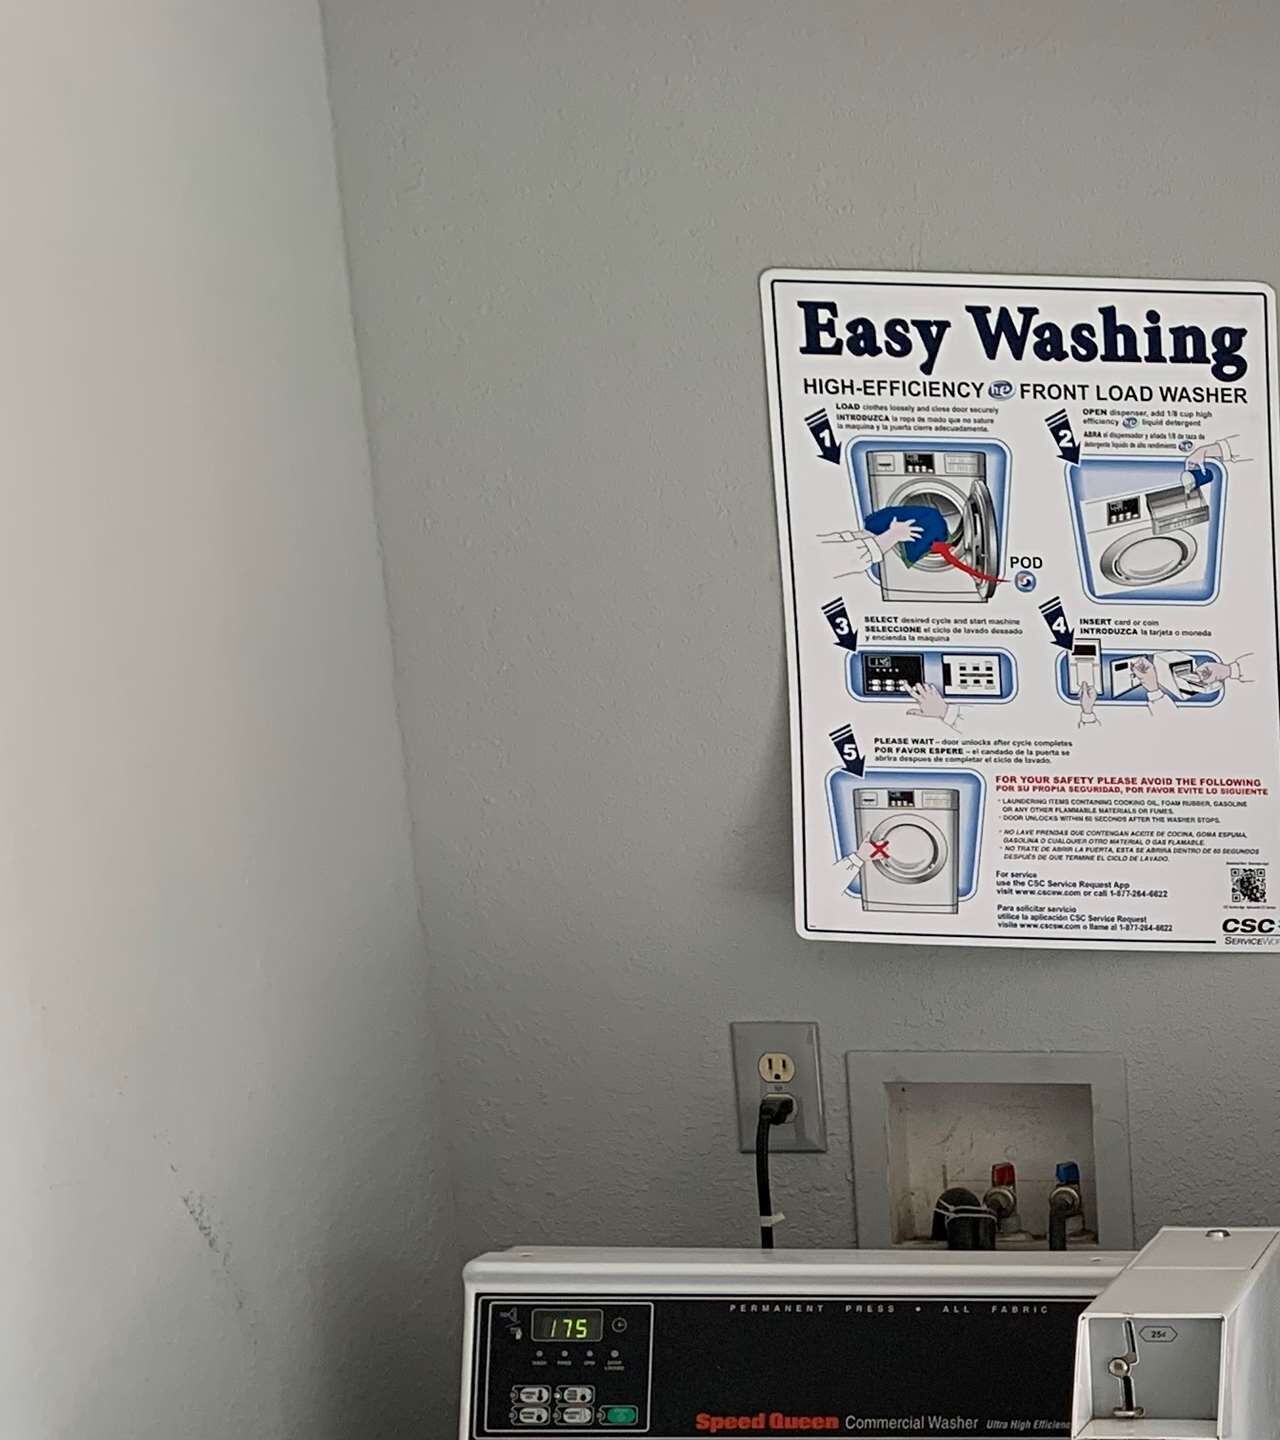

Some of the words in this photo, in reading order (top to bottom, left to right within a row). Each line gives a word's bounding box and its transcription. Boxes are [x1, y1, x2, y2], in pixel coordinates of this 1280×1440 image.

[797, 300, 951, 375] Easy
[965, 304, 1248, 381] Washing
[804, 378, 984, 398] HIGH-EFFICIENCY
[1020, 383, 1087, 400] FRONT
[1096, 385, 1152, 401] LOAD
[1160, 386, 1246, 403] WASHER
[819, 429, 831, 447] 1
[1058, 430, 1073, 448] 2
[1010, 556, 1042, 568] POD
[834, 617, 849, 635] 3
[1052, 616, 1067, 634] 4
[843, 744, 857, 761] 5
[996, 775, 1016, 783] FOR
[1053, 776, 1092, 784] SAFETY
[1097, 776, 1136, 784] PLEASE
[1141, 777, 1172, 785] AVOID
[1176, 777, 1196, 785] THE
[1199, 778, 1260, 786] FOLLOWING
[1177, 786, 1203, 794] EVITE
[1222, 918, 1275, 933] CSC
[730, 1304, 823, 1312] PERMANENT
[845, 1304, 894, 1312] PRESS
[550, 1319, 588, 1338] 175
[695, 1412, 765, 1433] Speed
[768, 1412, 839, 1430] Queen
[845, 1415, 925, 1430] Commercial
[927, 1415, 979, 1430] Washer
[1010, 1419, 1031, 1431] High
[1033, 1419, 1072, 1430] Efficienc
